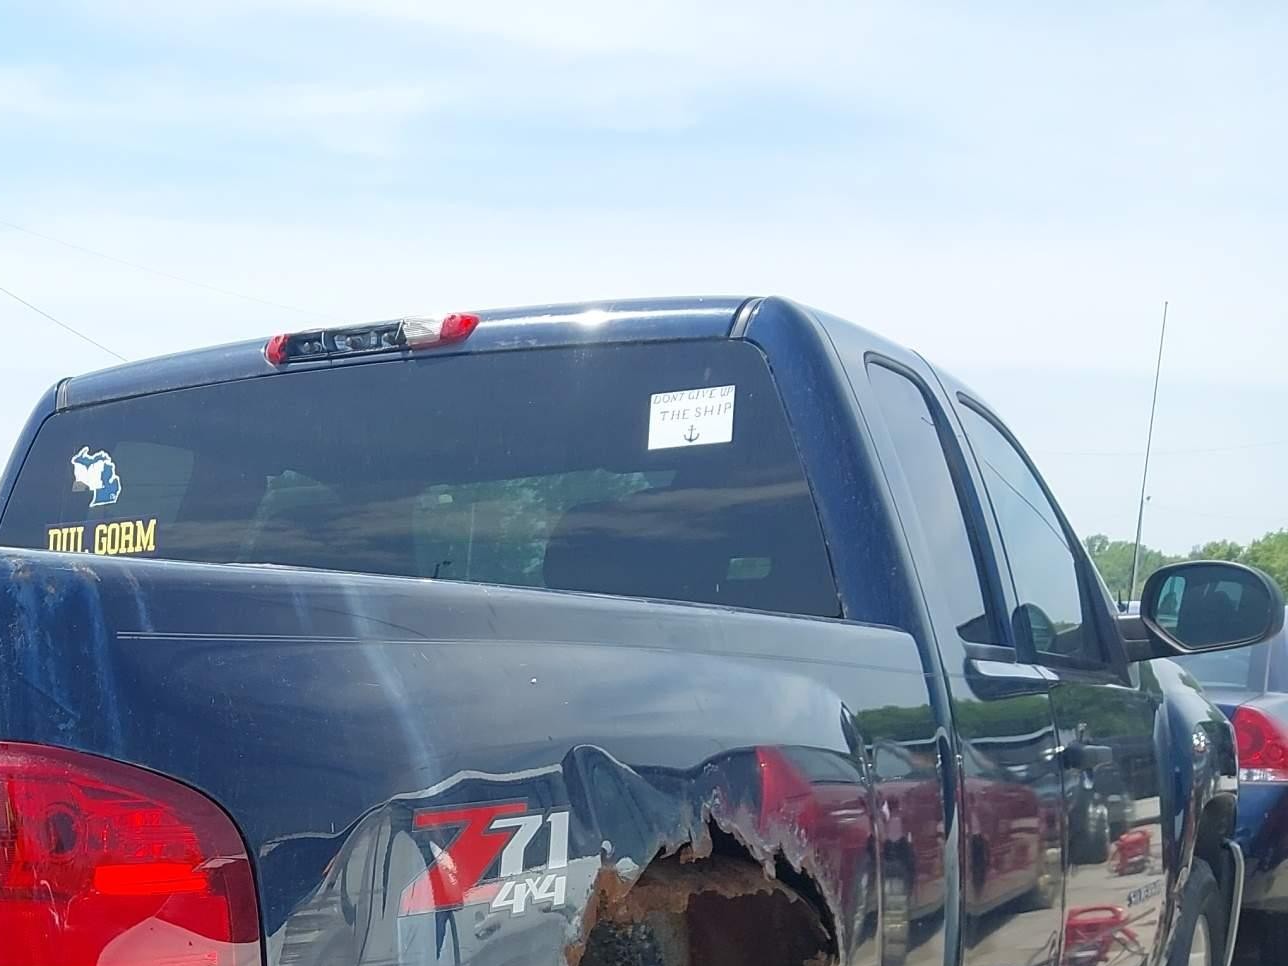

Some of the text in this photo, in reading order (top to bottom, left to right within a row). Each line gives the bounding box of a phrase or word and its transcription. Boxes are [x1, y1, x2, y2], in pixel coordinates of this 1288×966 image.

[688, 389, 718, 400] GIVE
[660, 402, 732, 421] THE SHIP
[94, 519, 157, 555] GORM
[397, 802, 570, 916] Z71
